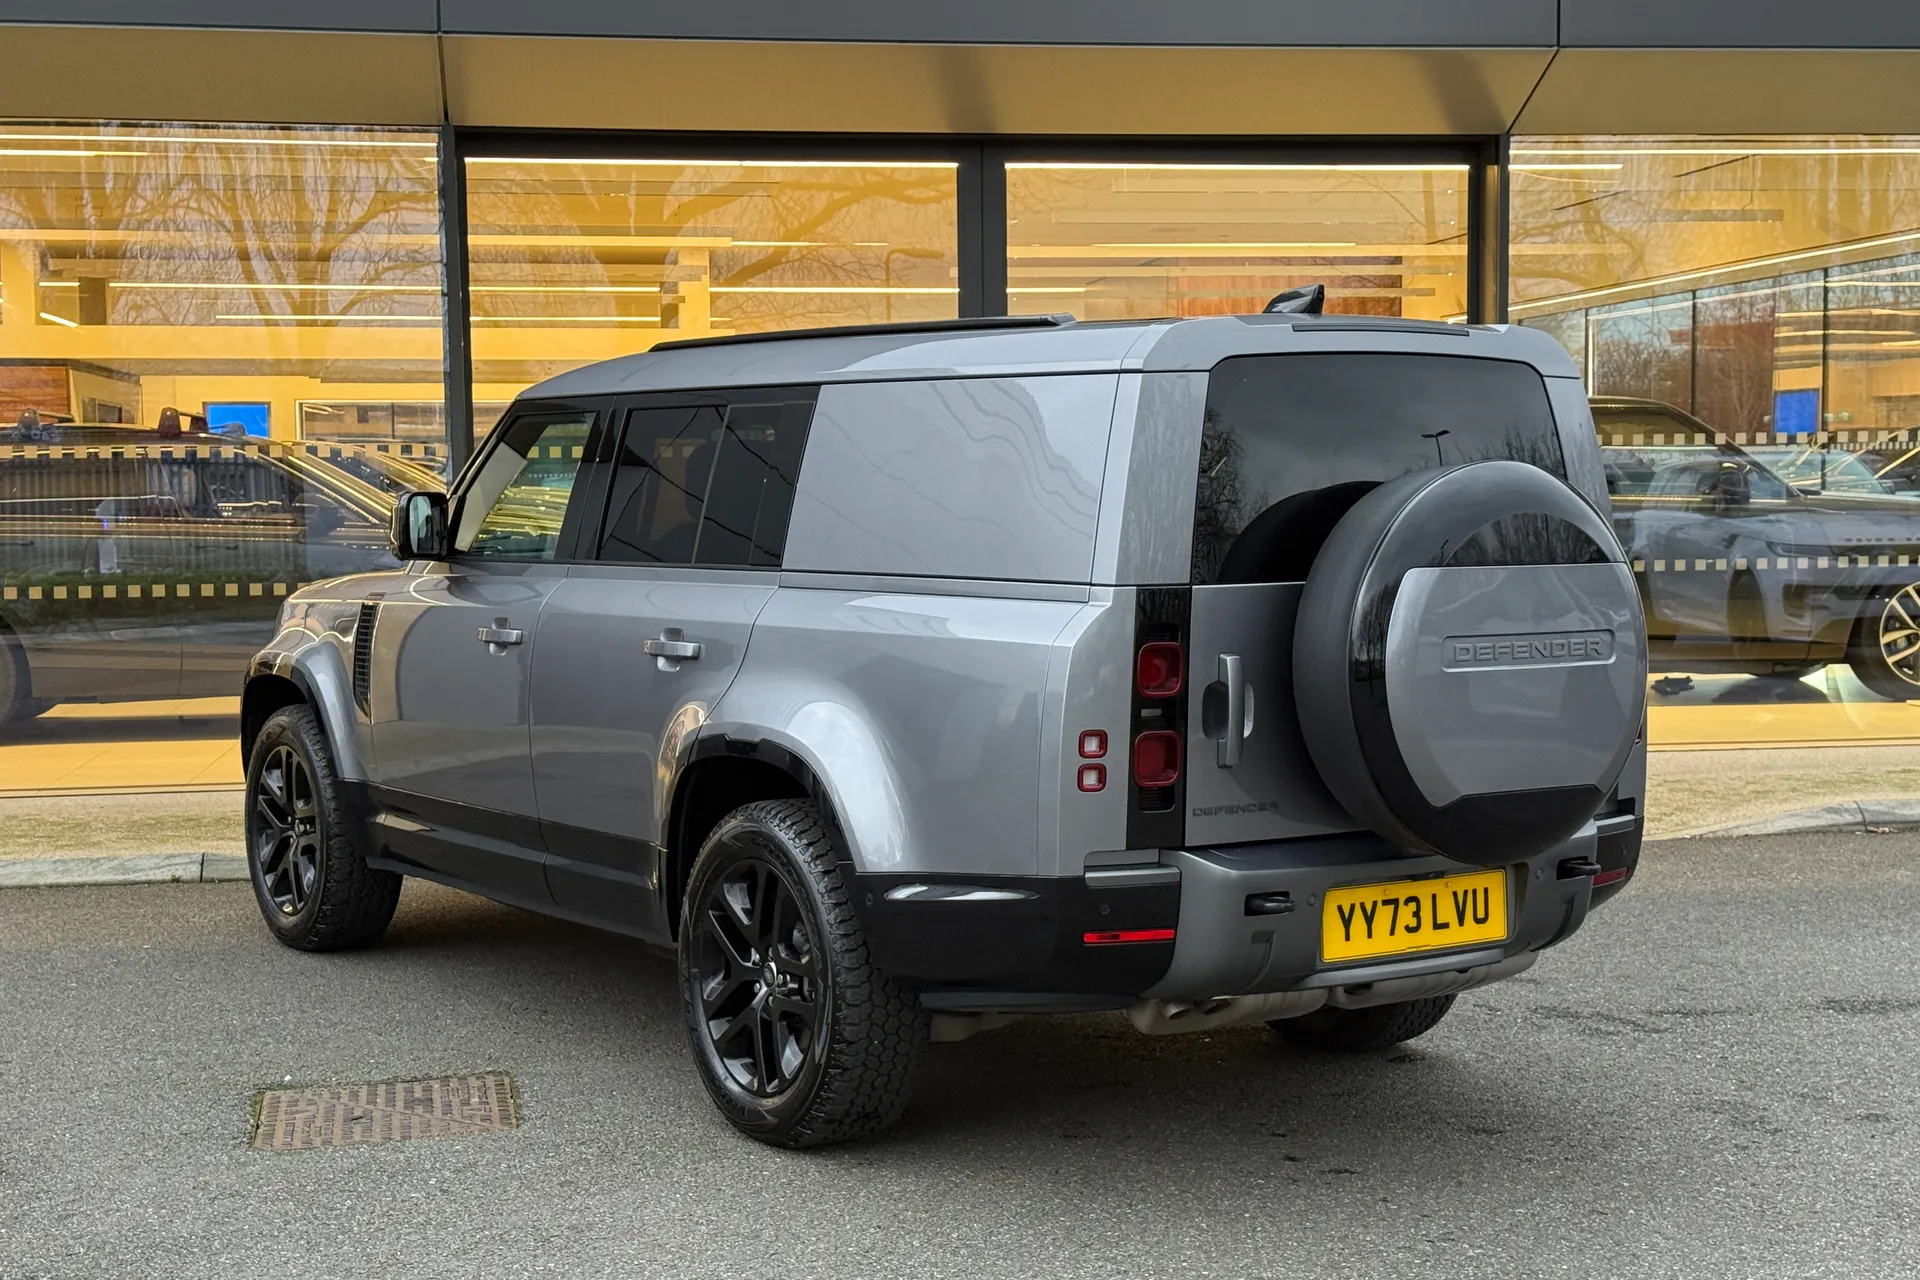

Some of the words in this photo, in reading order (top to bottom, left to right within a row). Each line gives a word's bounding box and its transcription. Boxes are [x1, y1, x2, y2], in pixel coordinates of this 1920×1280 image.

[1453, 637, 1604, 663] DEFENDER
[1192, 801, 1279, 817] DEFENDER
[1337, 896, 1422, 942] YY73
[1431, 887, 1489, 931] LVU
